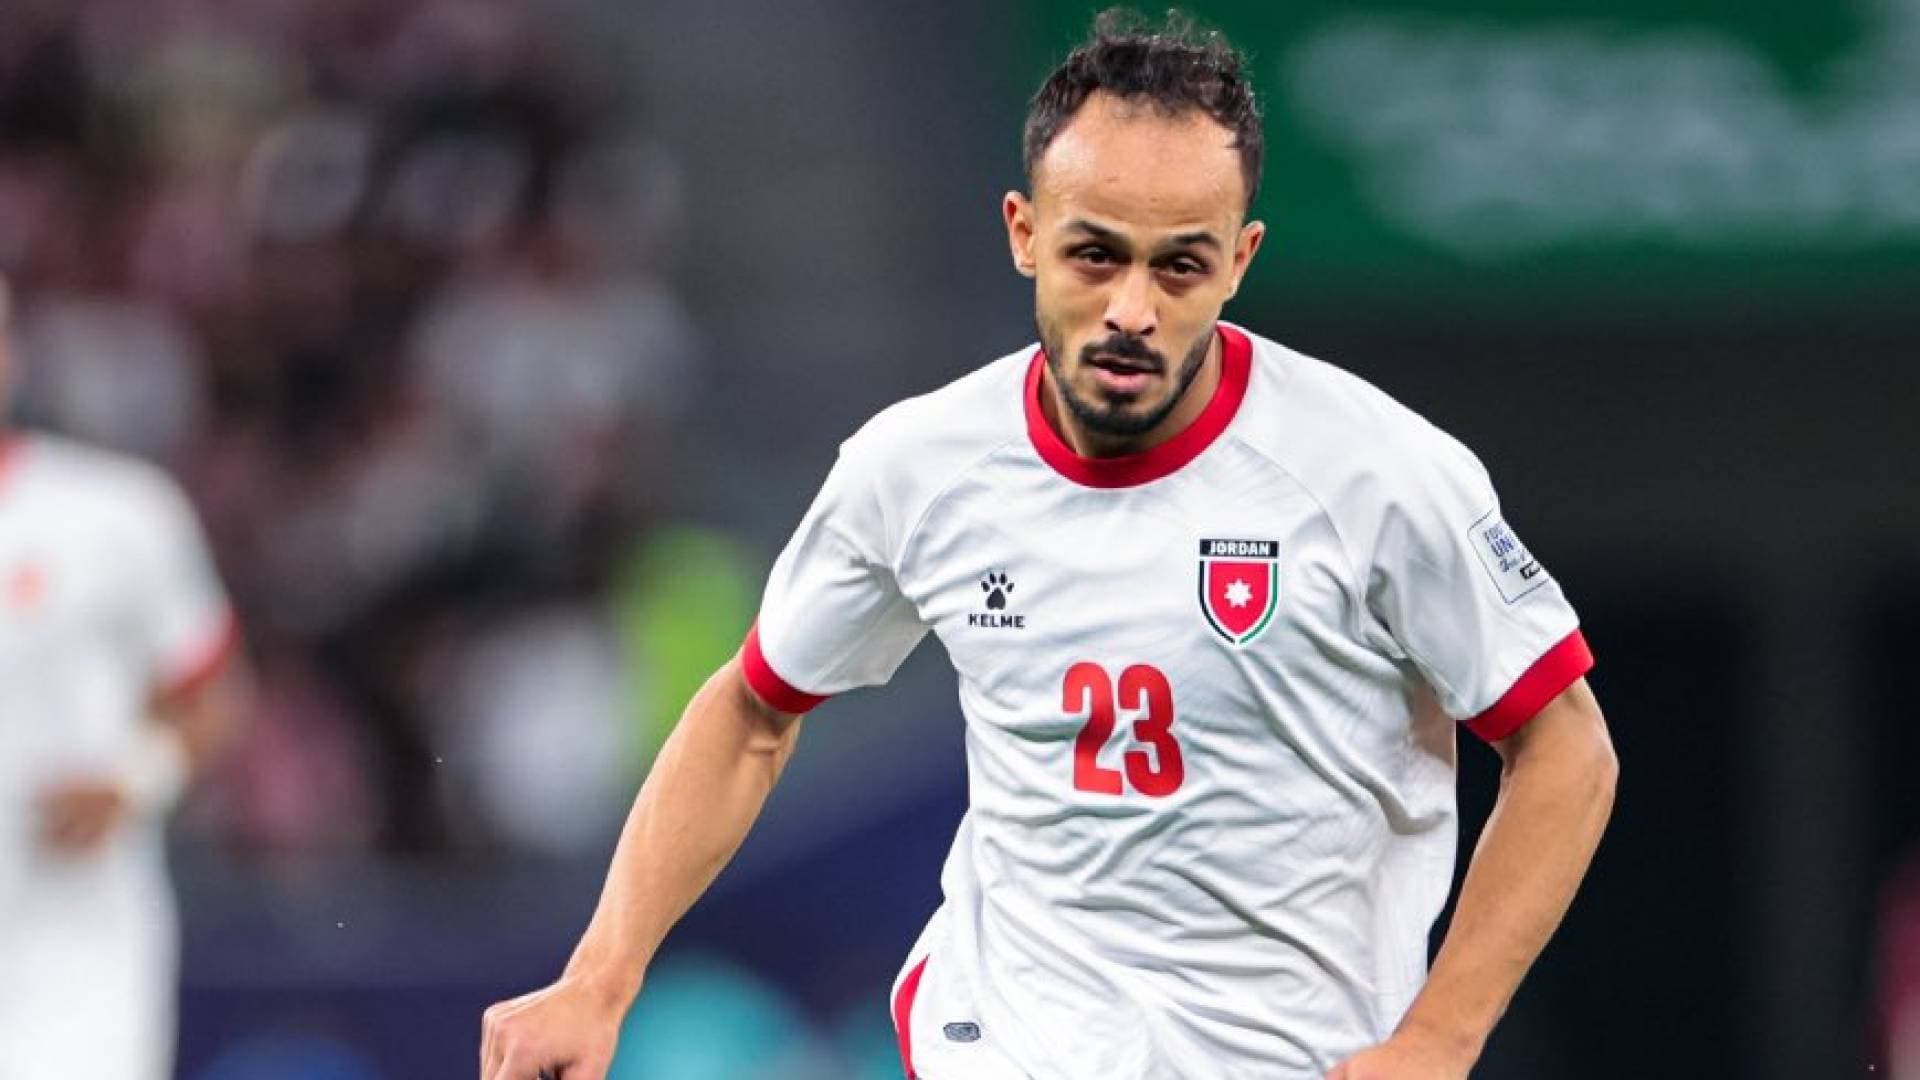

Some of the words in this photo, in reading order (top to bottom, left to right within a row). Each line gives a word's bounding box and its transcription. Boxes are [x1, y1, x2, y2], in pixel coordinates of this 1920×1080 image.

[1208, 540, 1269, 556] JORDAN
[968, 613, 1025, 629] KELME
[1062, 661, 1185, 798] 23
